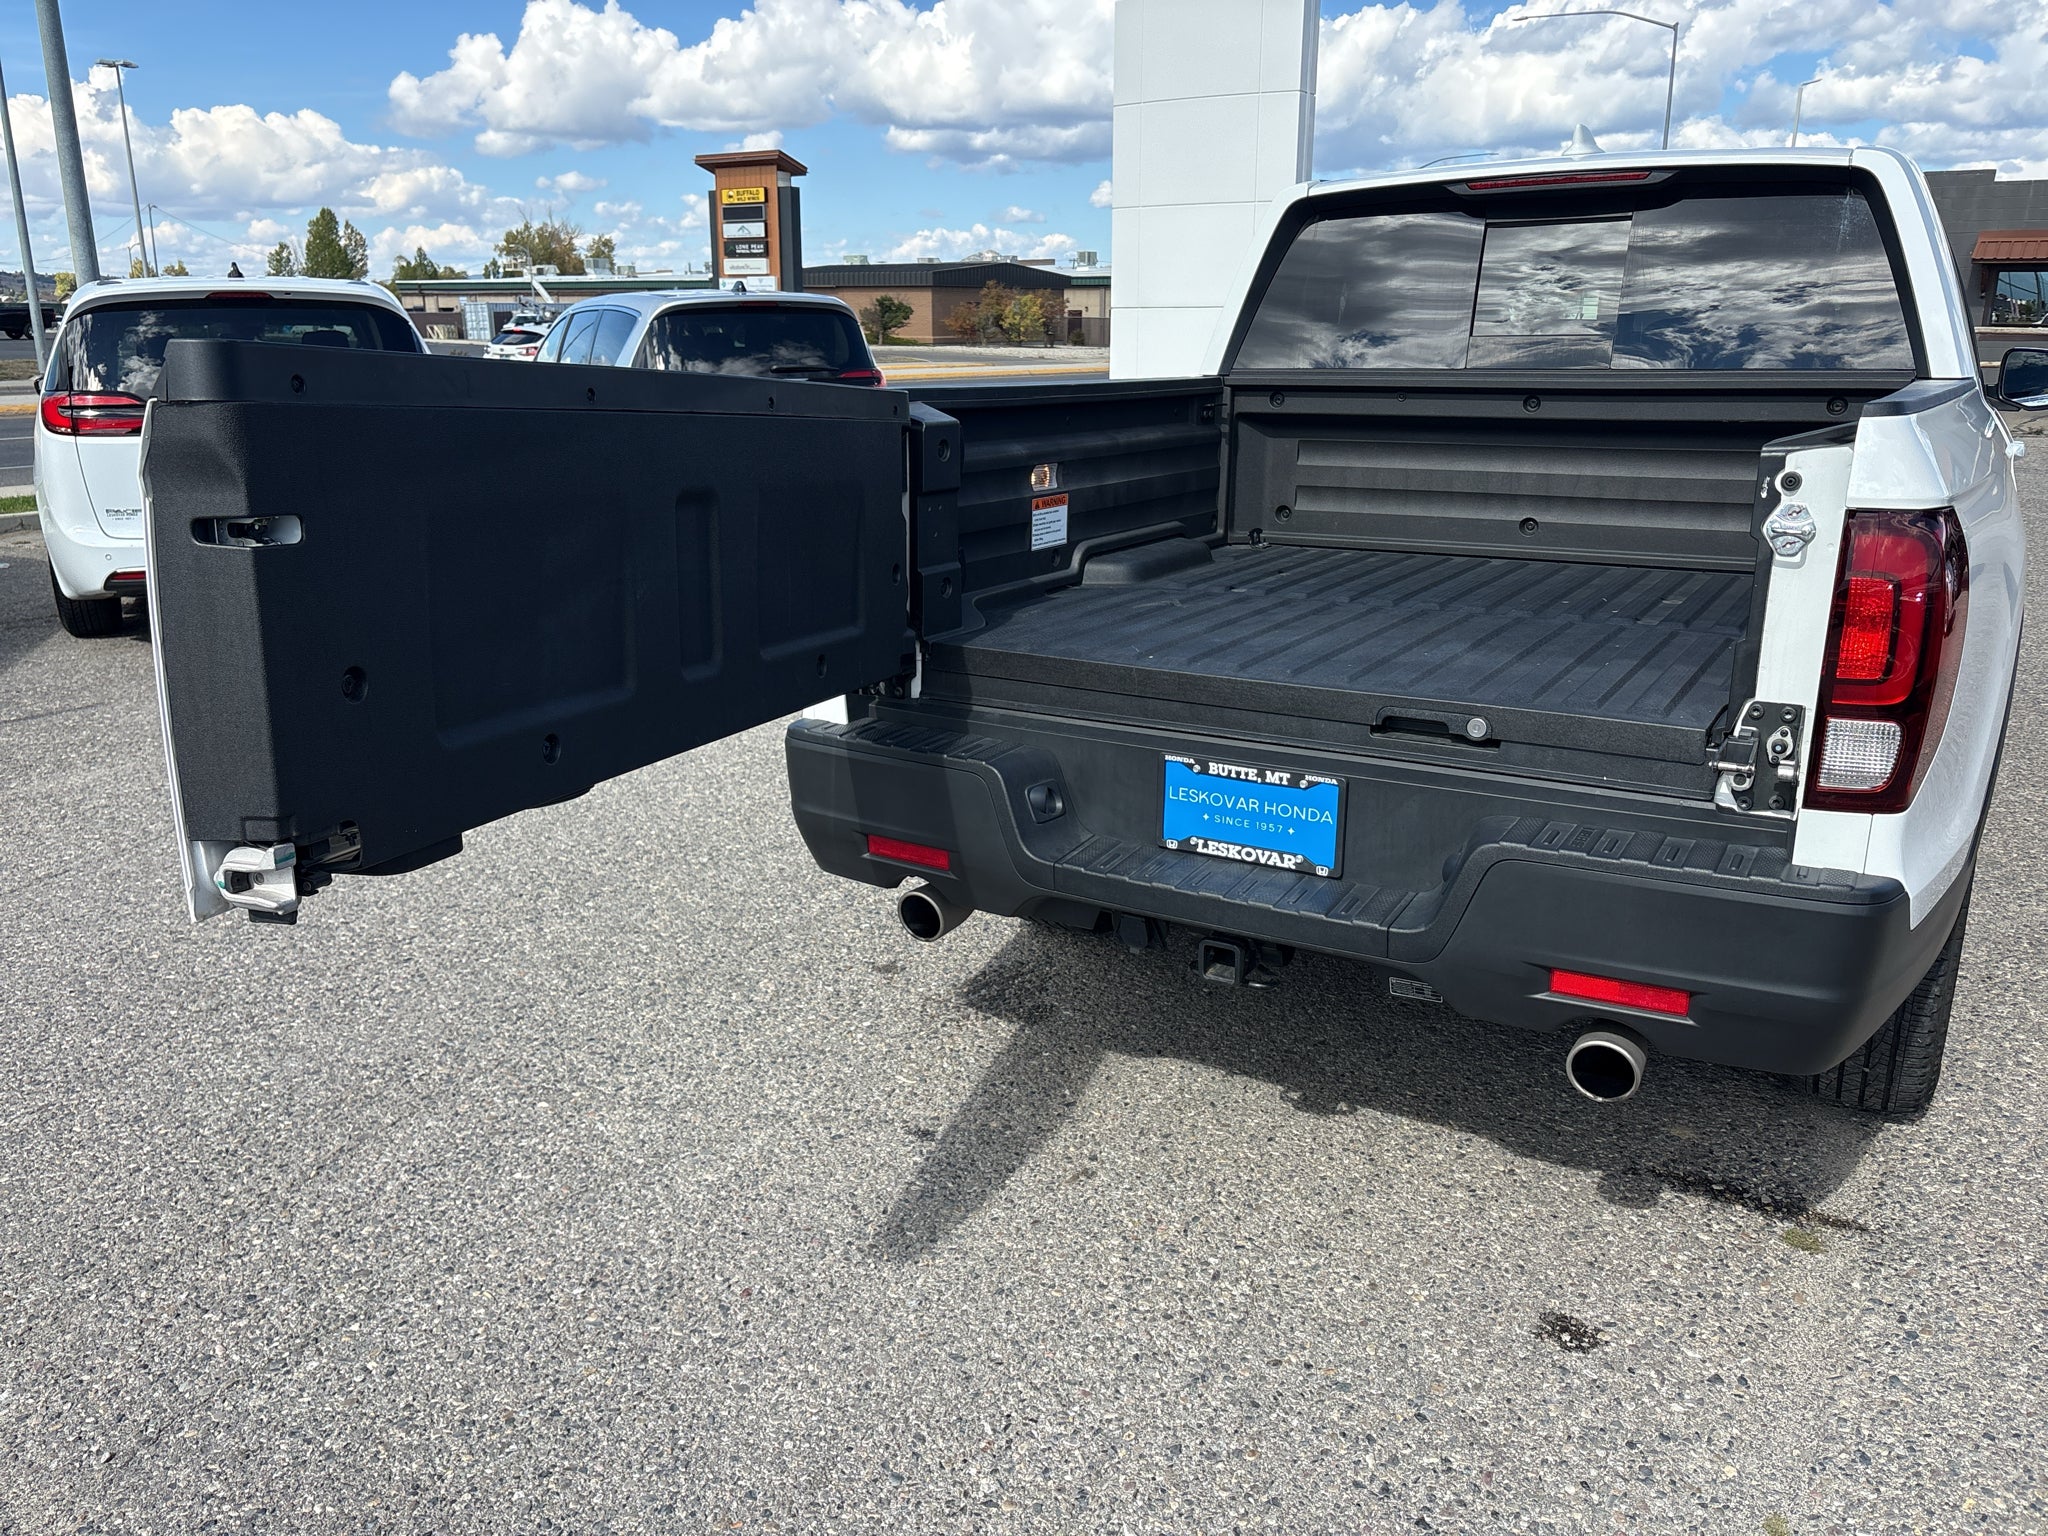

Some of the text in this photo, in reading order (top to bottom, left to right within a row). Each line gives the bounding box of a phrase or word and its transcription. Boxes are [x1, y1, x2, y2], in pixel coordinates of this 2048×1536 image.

[1042, 496, 1066, 508] WARNING
[1164, 754, 1195, 764] HONDA
[1208, 762, 1290, 785] BUTTE, MT
[1304, 774, 1338, 784] HONDA
[1169, 786, 1333, 824] LESKOVAR HONDA
[1214, 814, 1284, 833] SINCE 1957
[1196, 838, 1296, 870] LESKOVAR
